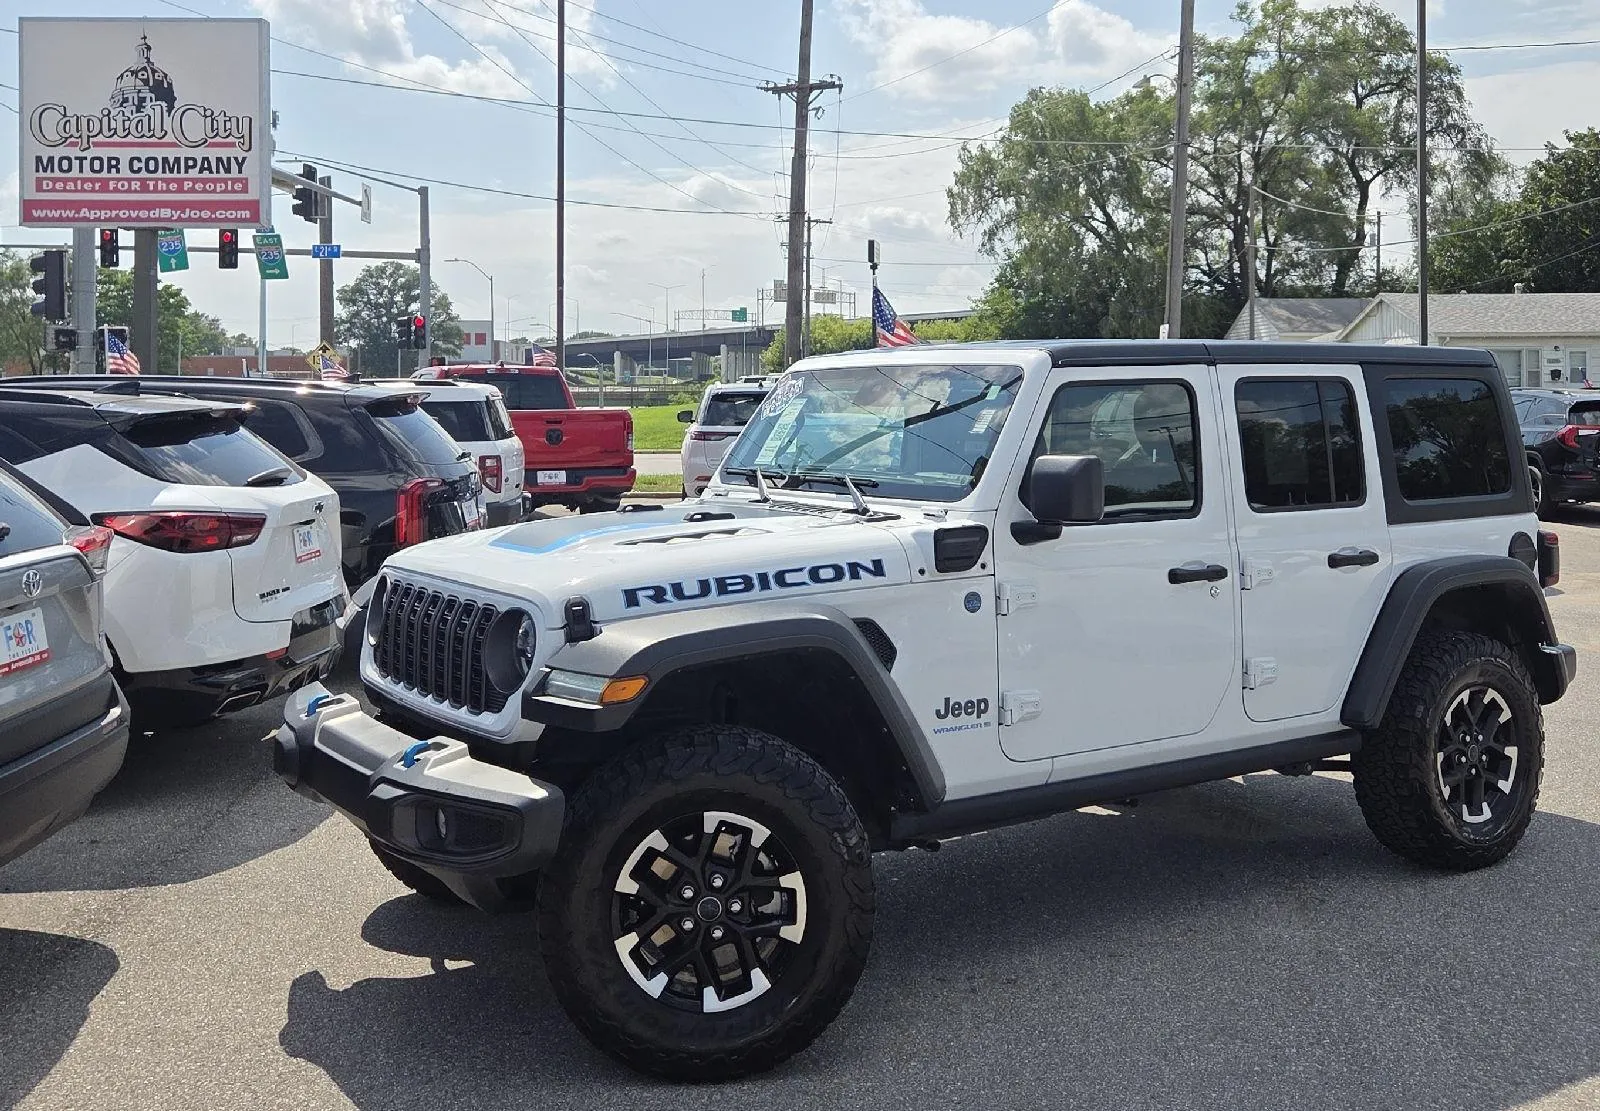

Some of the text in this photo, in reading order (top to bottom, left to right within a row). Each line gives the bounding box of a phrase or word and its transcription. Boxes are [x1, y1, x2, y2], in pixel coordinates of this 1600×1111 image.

[30, 103, 253, 152] Capital City
[35, 156, 248, 175] MOTOR COMPANY
[42, 180, 243, 193] Dealer FOR The People
[32, 207, 250, 221] www.ApprovedByJoe.com
[161, 240, 182, 251] 235
[256, 236, 278, 245] EAST
[261, 250, 280, 260] 235
[621, 558, 887, 609] RUBICON
[935, 697, 989, 720] Jeep
